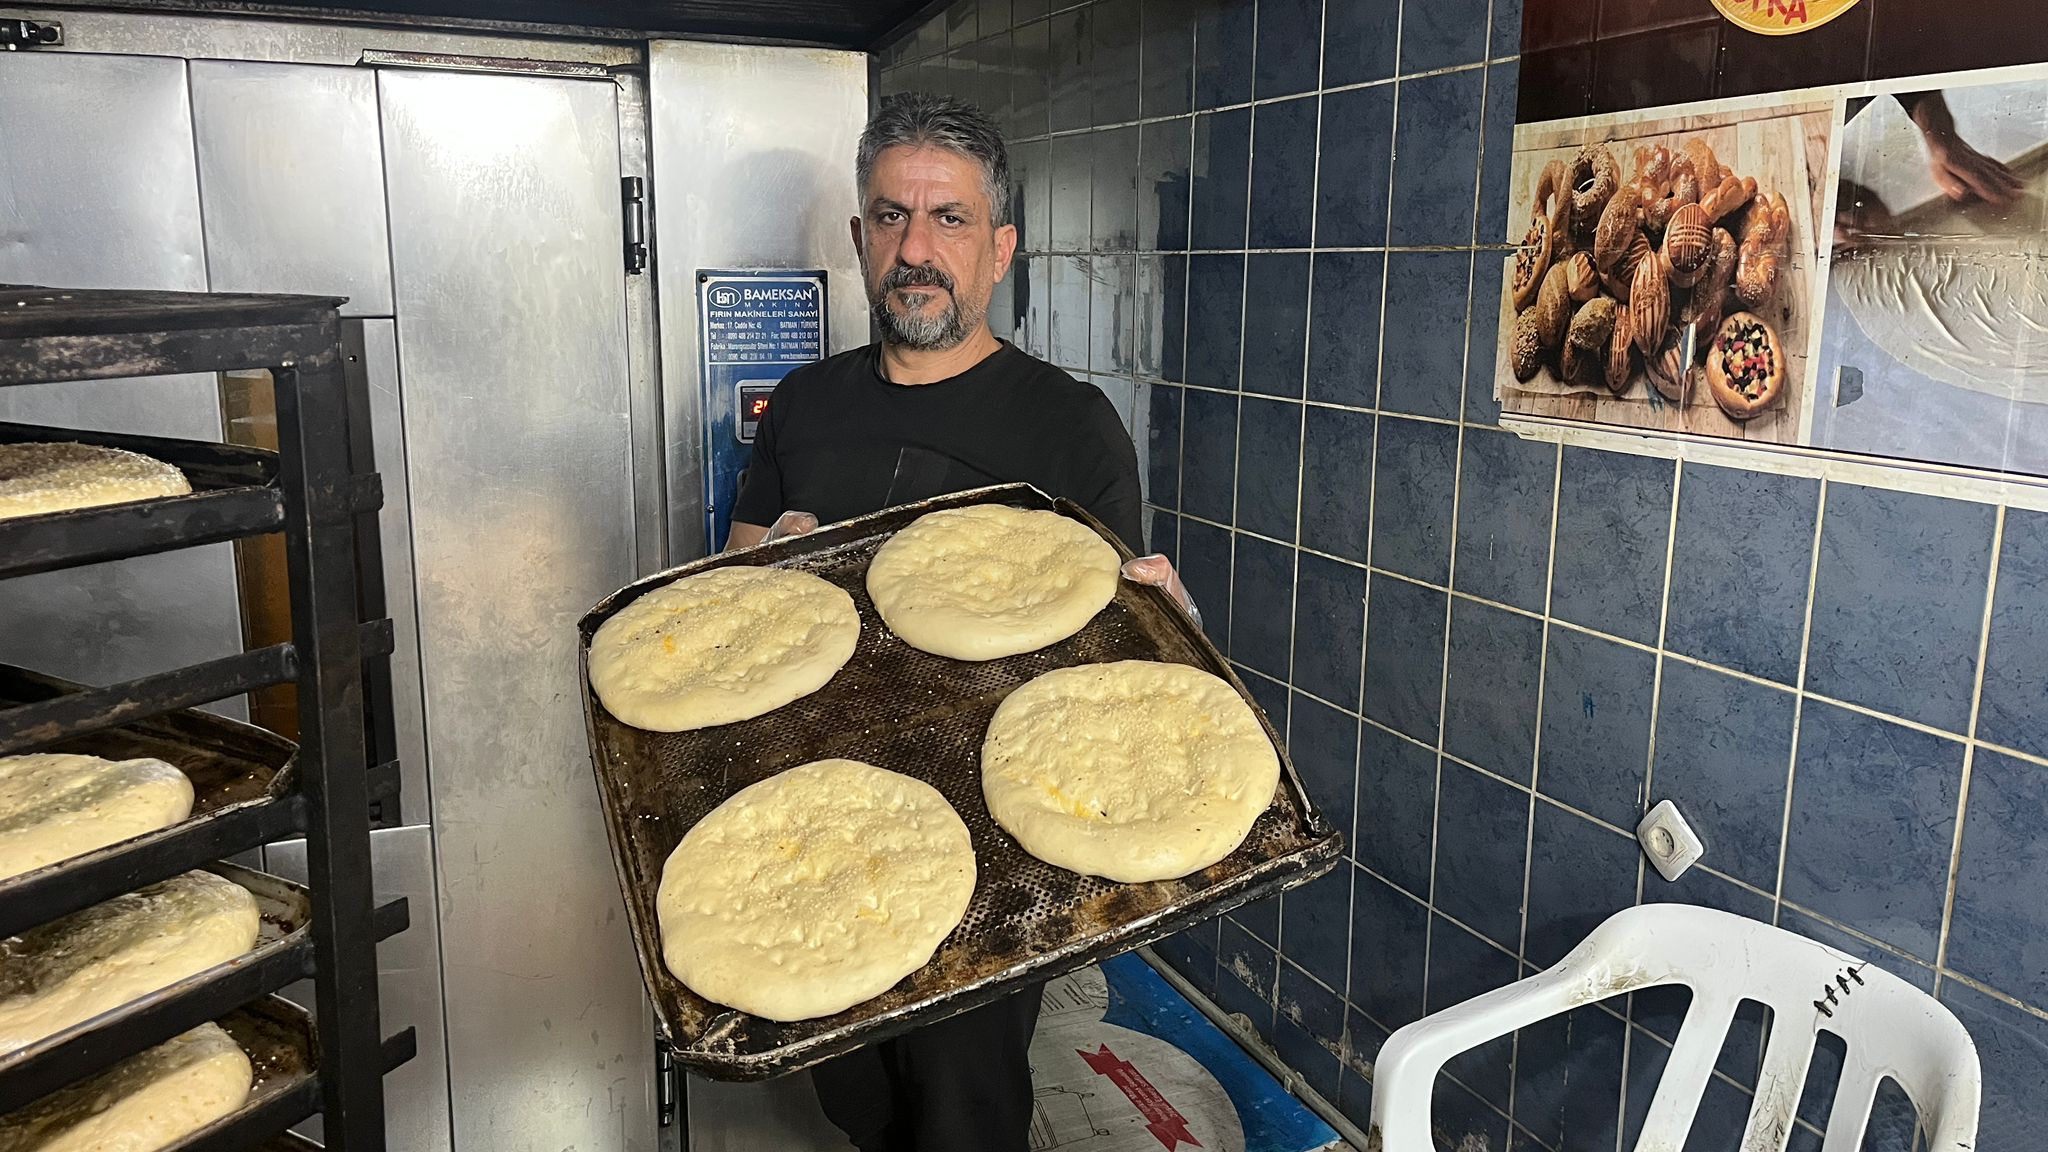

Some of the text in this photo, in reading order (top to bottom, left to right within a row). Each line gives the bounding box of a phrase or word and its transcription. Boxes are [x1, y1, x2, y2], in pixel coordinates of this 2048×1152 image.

[744, 288, 812, 301] BAMEKSAN
[710, 309, 818, 318] FIRIN MAKİNELERİ SANAYİ
[779, 321, 798, 329] BATMAN
[800, 319, 819, 329] TÜRKİYE
[780, 341, 799, 350] BATMAN
[801, 340, 819, 350] TÜRKİYE
